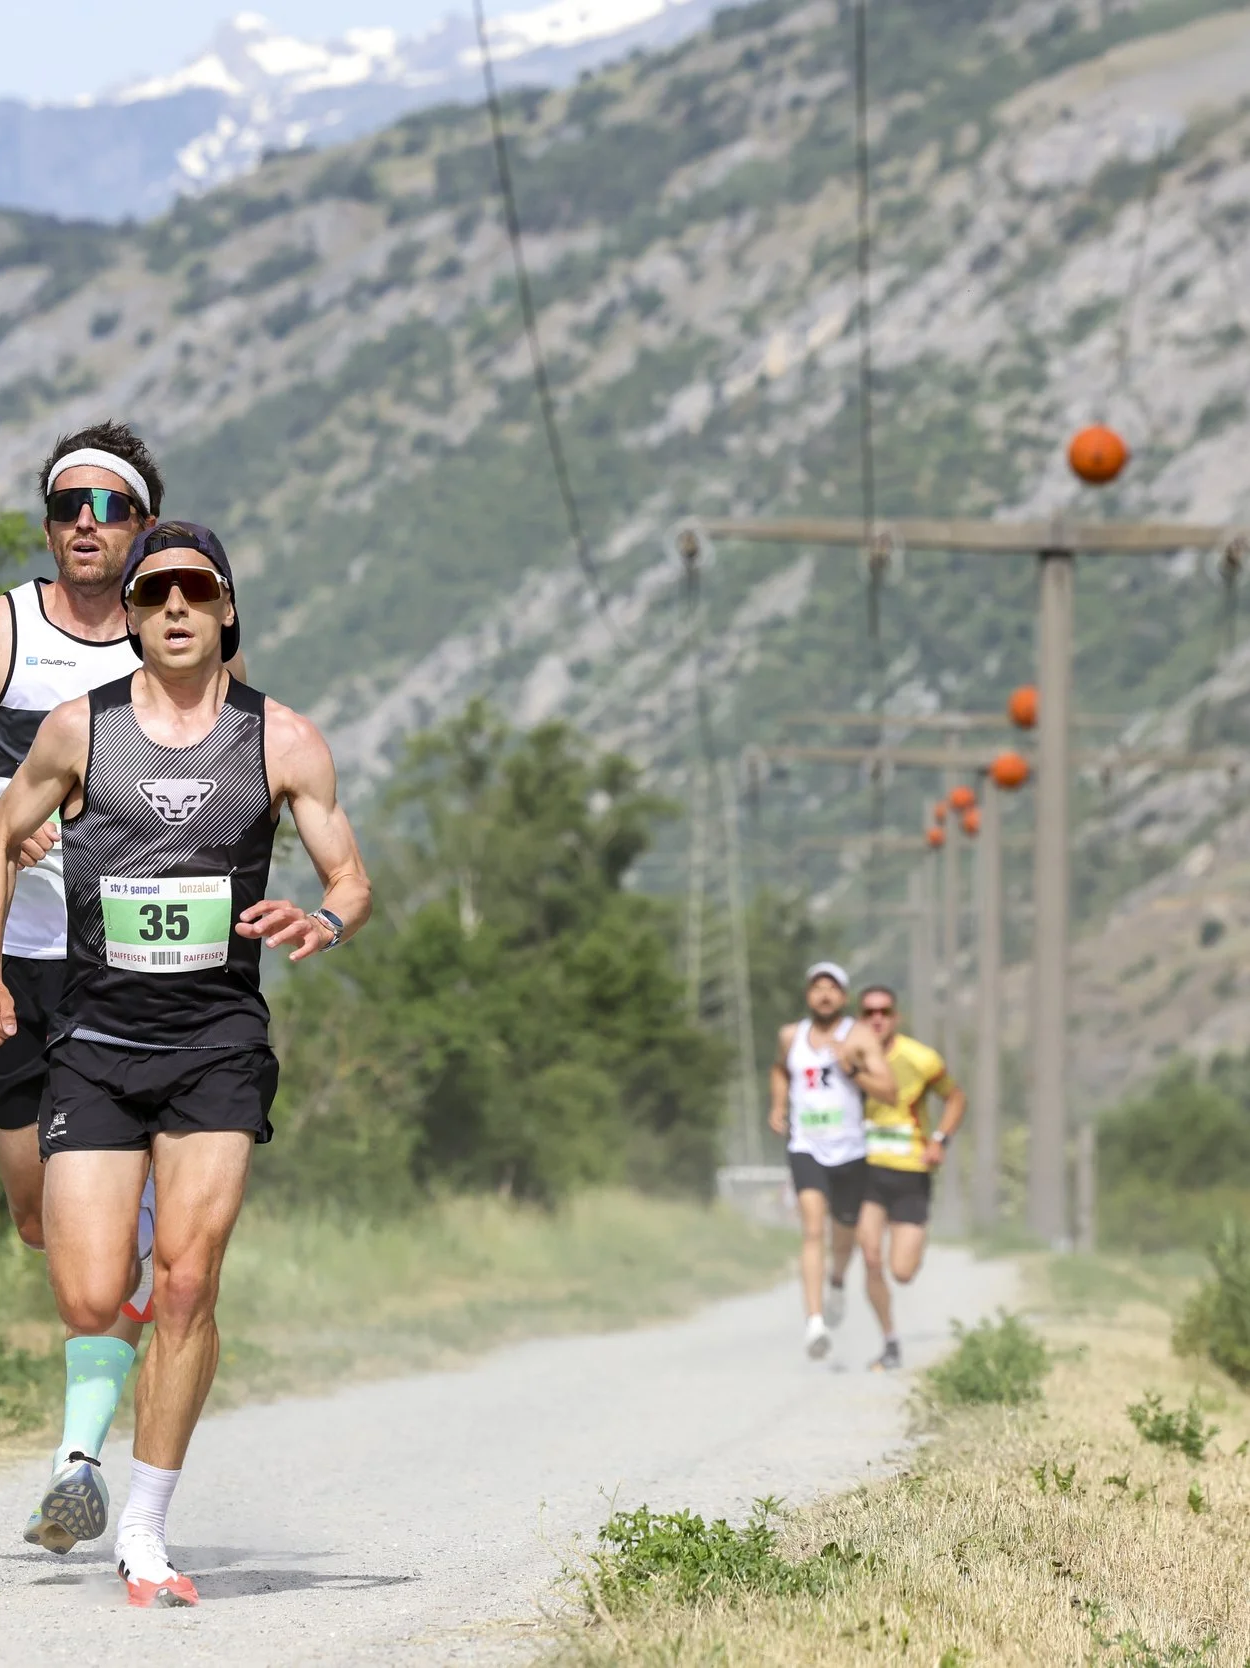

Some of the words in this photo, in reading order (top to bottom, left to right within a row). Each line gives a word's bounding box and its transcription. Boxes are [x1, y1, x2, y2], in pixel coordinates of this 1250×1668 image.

[110, 883, 121, 893] stv
[130, 884, 160, 895] gampel
[179, 882, 219, 894] lonzalauf
[139, 904, 190, 941] 35
[110, 951, 147, 962] RAIFFEISEN
[184, 951, 224, 962] RAIFFEISEN
